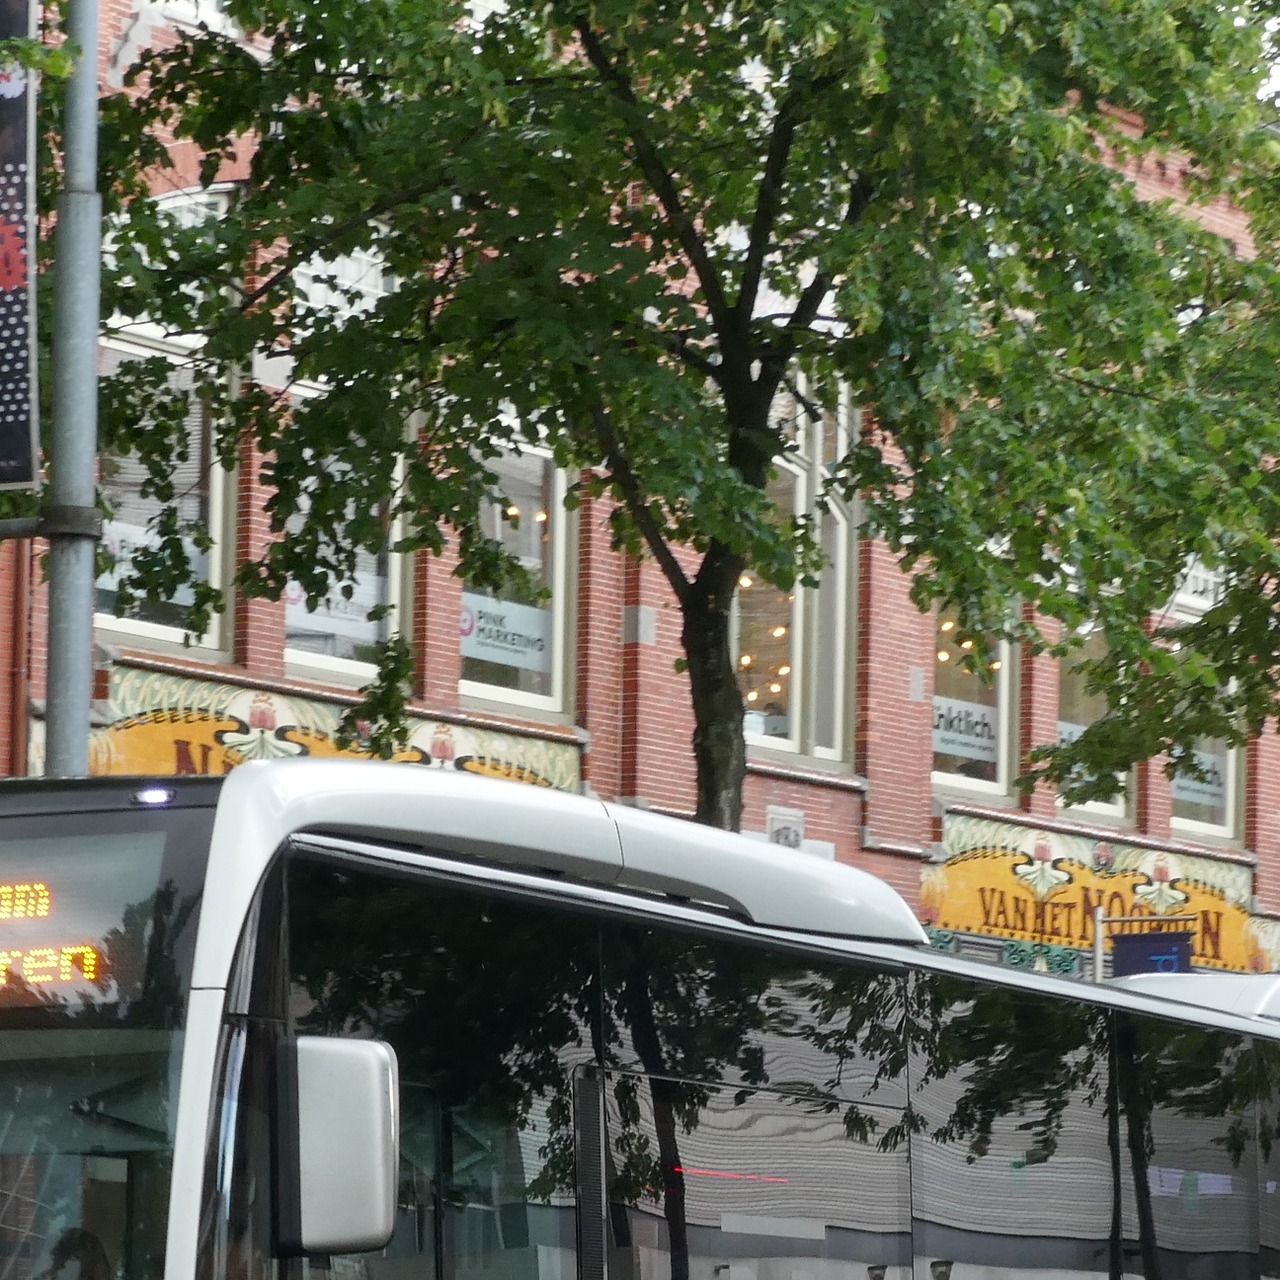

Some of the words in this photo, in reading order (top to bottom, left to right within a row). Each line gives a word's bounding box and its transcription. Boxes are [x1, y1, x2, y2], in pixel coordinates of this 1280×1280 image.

[477, 610, 507, 629] PINK
[477, 626, 545, 652] MARKETING
[978, 886, 1028, 931] VAN
